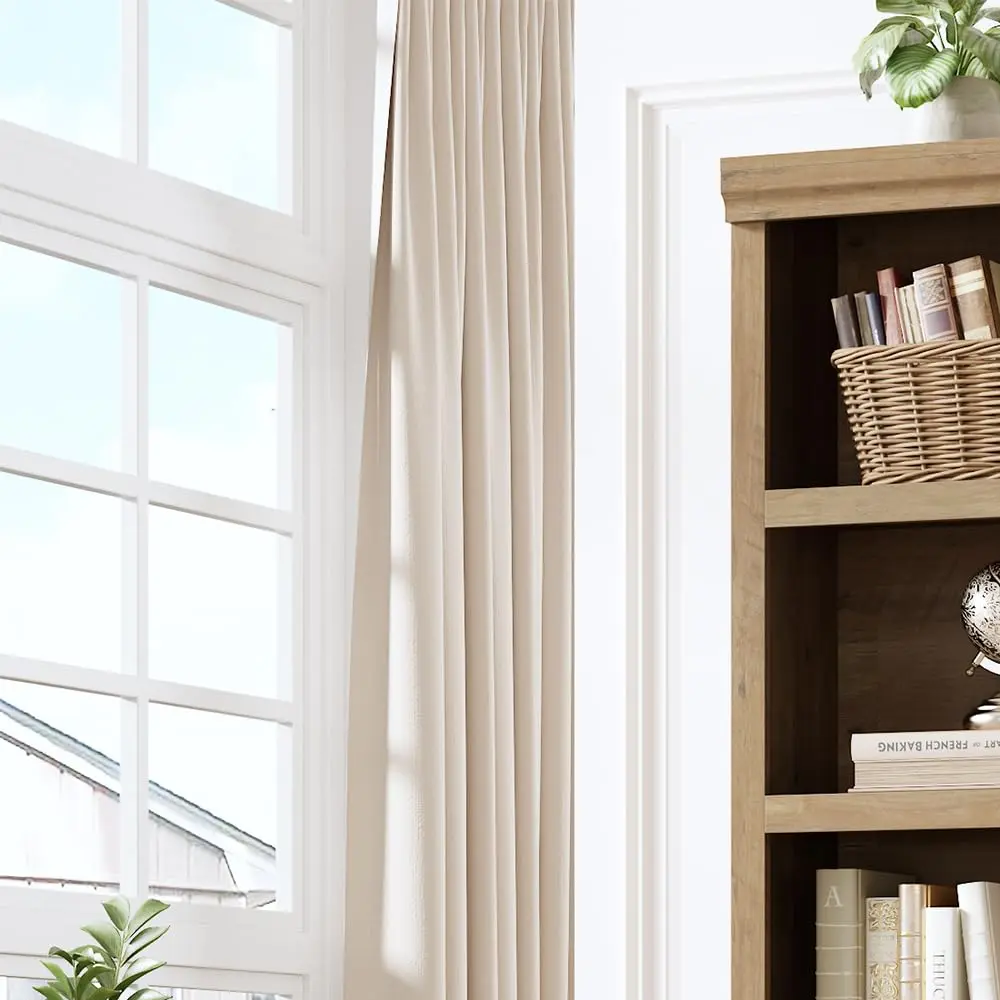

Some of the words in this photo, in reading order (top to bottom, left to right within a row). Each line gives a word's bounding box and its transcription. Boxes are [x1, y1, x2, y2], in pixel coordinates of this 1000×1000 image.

[877, 741, 922, 752] BAKING
[925, 740, 968, 750] FRENCH
[824, 885, 844, 908] A
